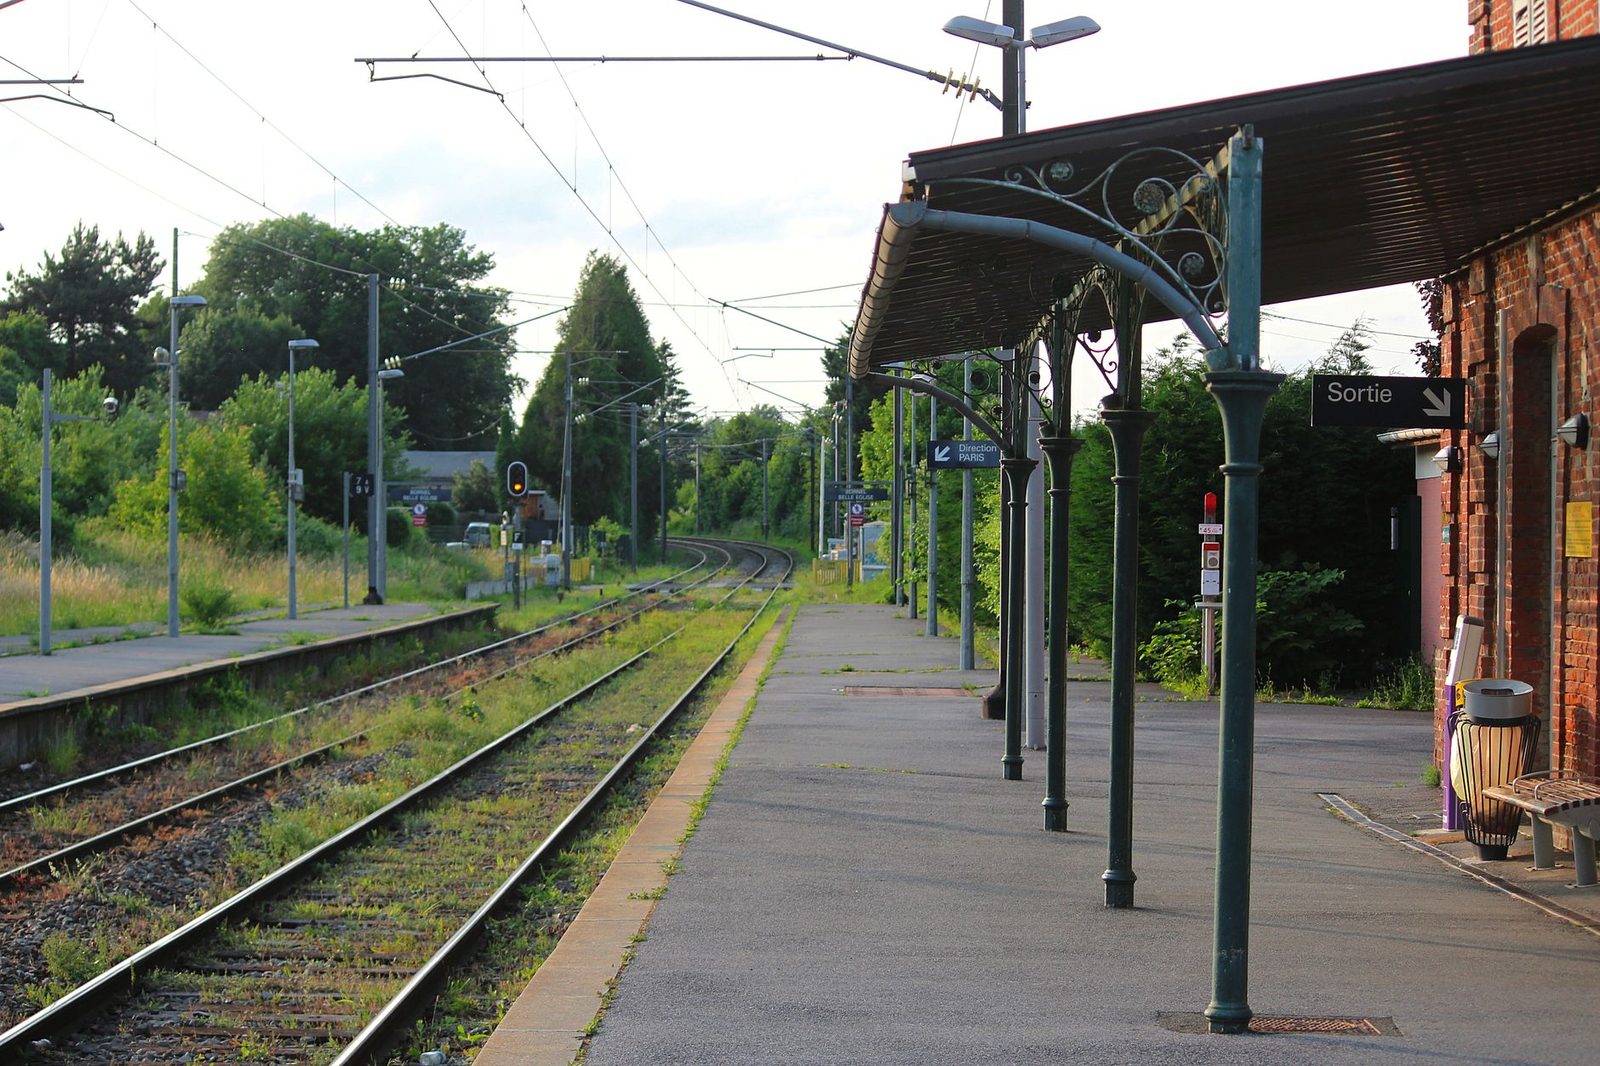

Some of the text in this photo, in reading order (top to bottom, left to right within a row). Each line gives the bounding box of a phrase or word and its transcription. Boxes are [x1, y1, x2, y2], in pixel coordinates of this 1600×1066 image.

[1327, 382, 1393, 403] Sortie
[958, 444, 997, 452] Direction
[958, 454, 985, 462] PARIS
